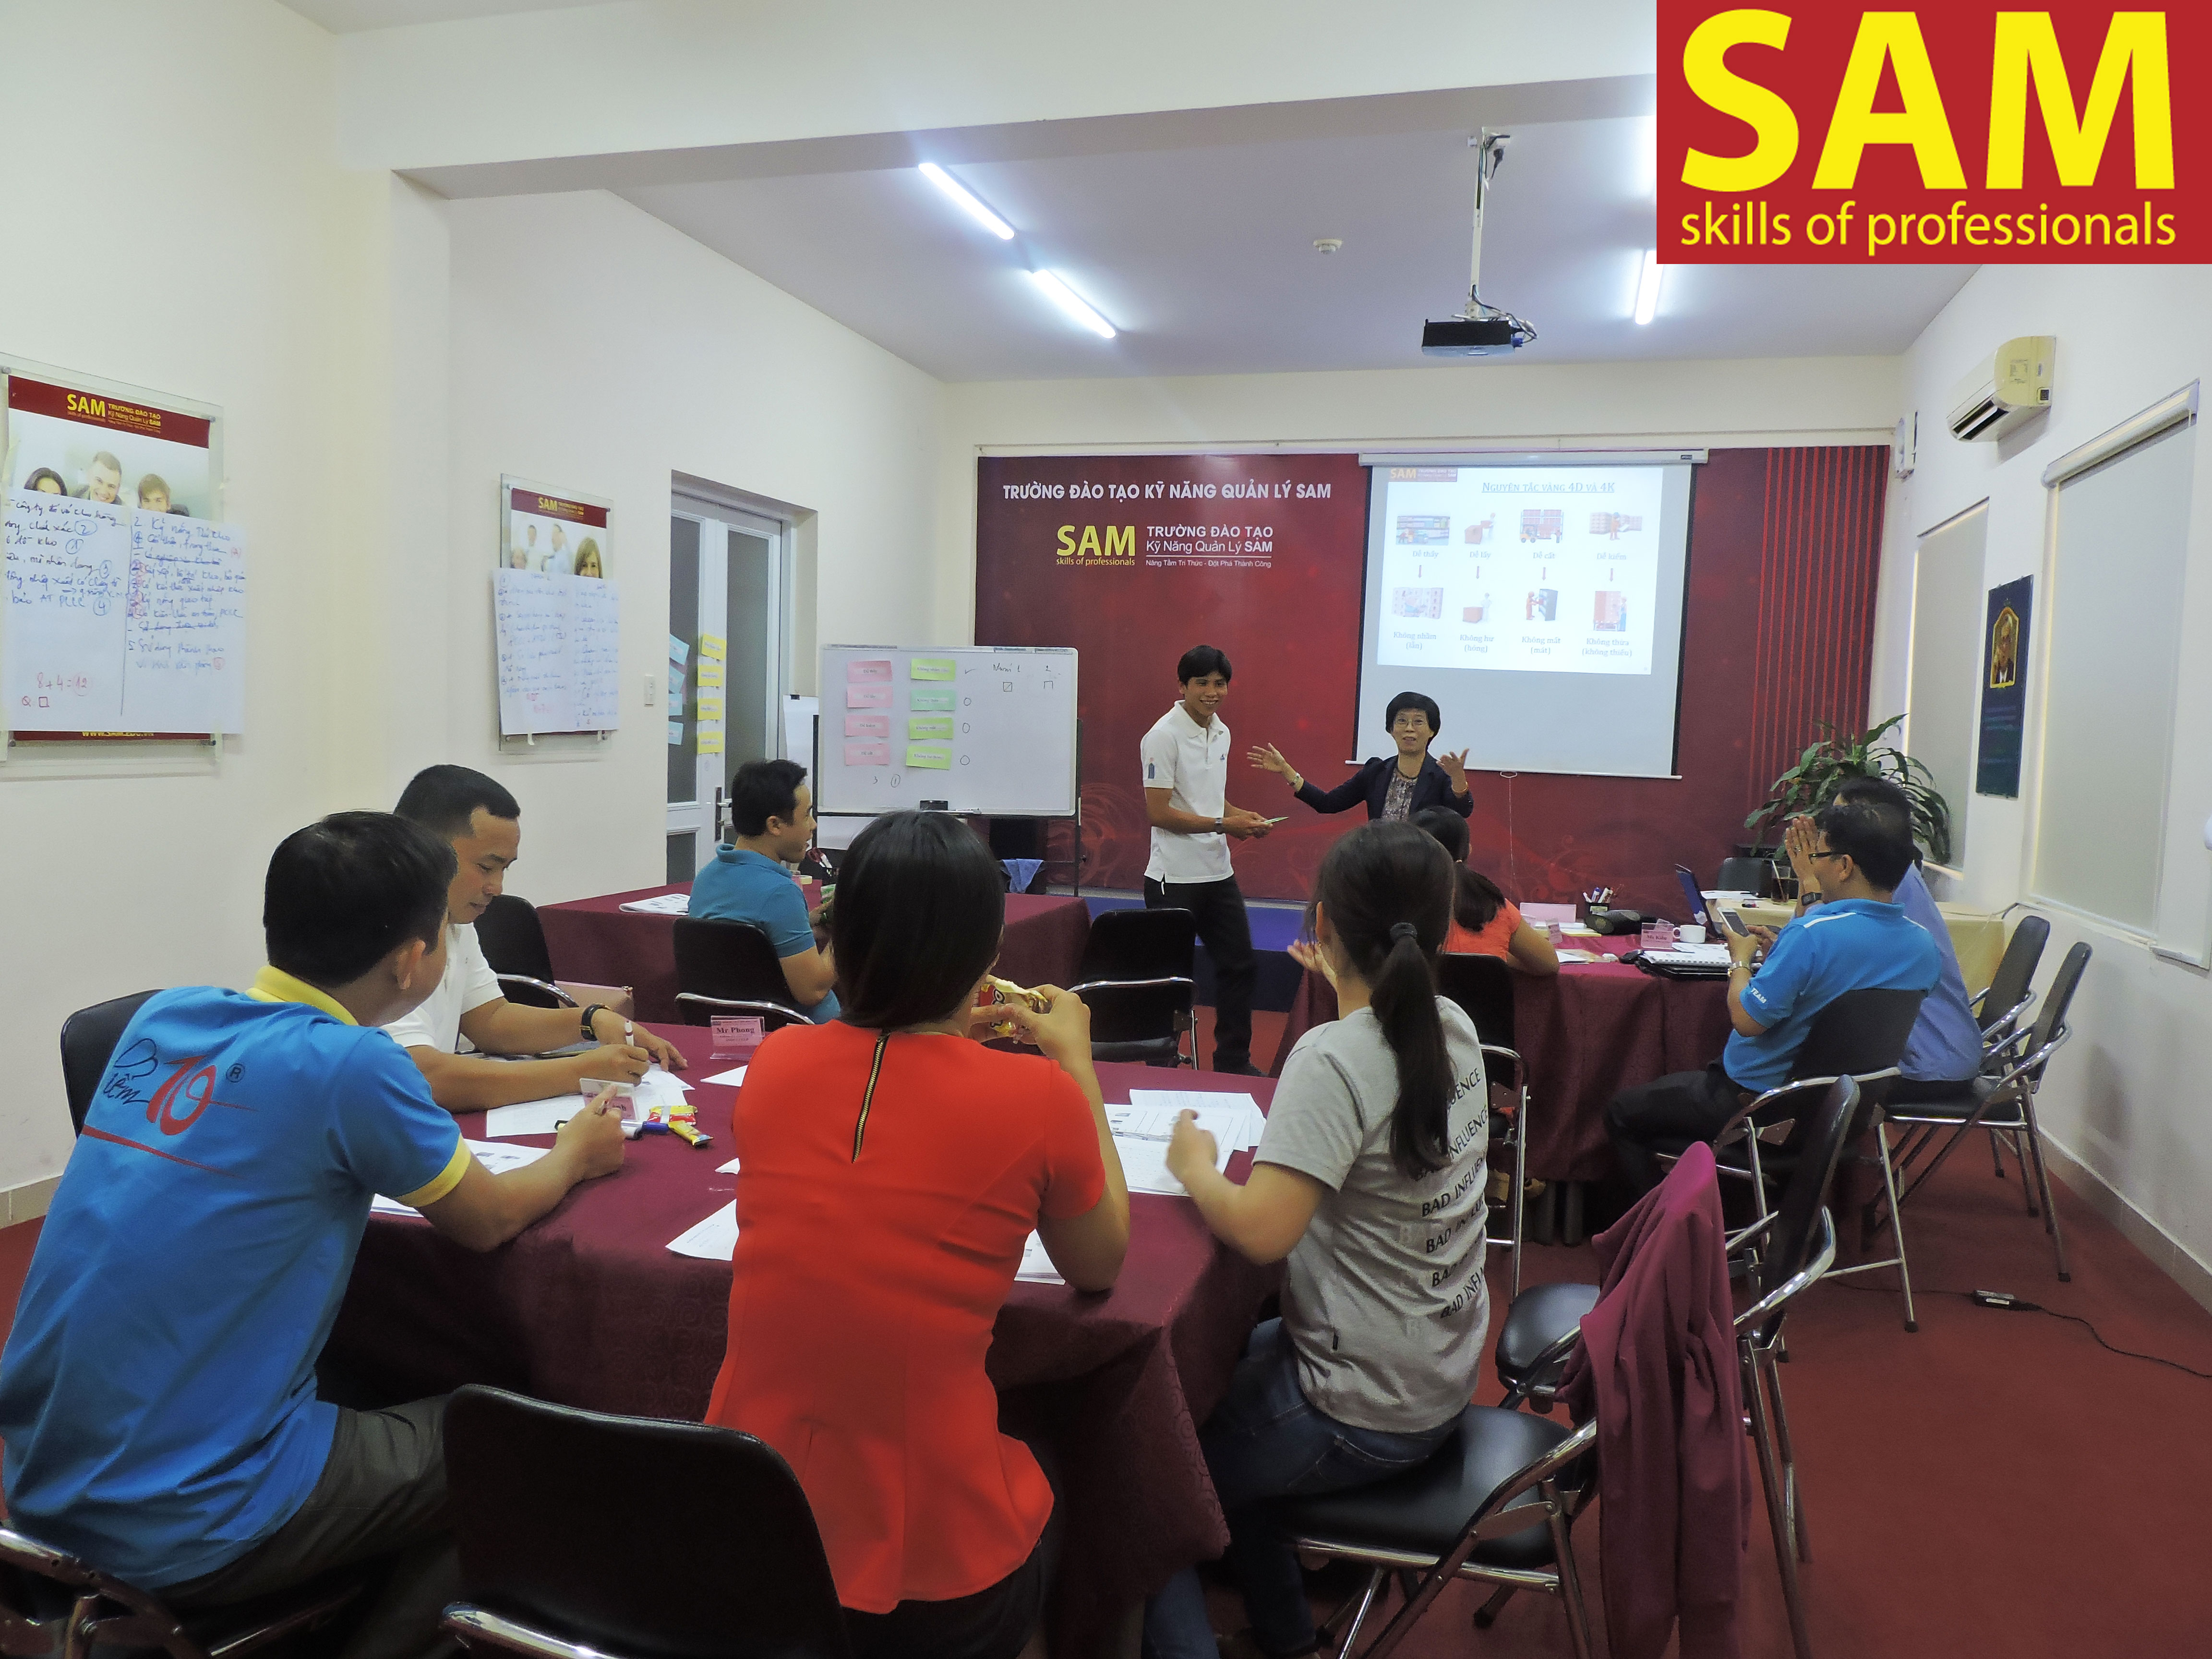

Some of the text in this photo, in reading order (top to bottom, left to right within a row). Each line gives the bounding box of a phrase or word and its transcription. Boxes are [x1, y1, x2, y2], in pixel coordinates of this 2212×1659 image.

[67, 394, 106, 417] SAM
[1390, 468, 1416, 479] SAM
[1003, 479, 1332, 503] TRƯỜNG ĐÀO TẠO KỸ NĂNG QUẢN LÝ SAM
[1568, 482, 1583, 492] 4D
[1600, 482, 1615, 492] 4K
[538, 497, 558, 512] SAM
[1147, 524, 1274, 540] TRƯỜNG ĐÀO TẠO
[1056, 525, 1136, 556] SAM
[1146, 540, 1273, 554] Kỹ Năng Quản Lý SAM
[1056, 557, 1135, 567] skills of professionals
[1394, 631, 1415, 640] Không
[1460, 634, 1482, 643] Không
[1522, 636, 1545, 645] Không
[1587, 638, 1610, 646] Không
[1582, 648, 1608, 657] (không
[1751, 987, 1767, 1004] TEAM
[1422, 1193, 1451, 1217] BAD
[1426, 1228, 1452, 1254] BAD
[1440, 1294, 1464, 1319] BAD
